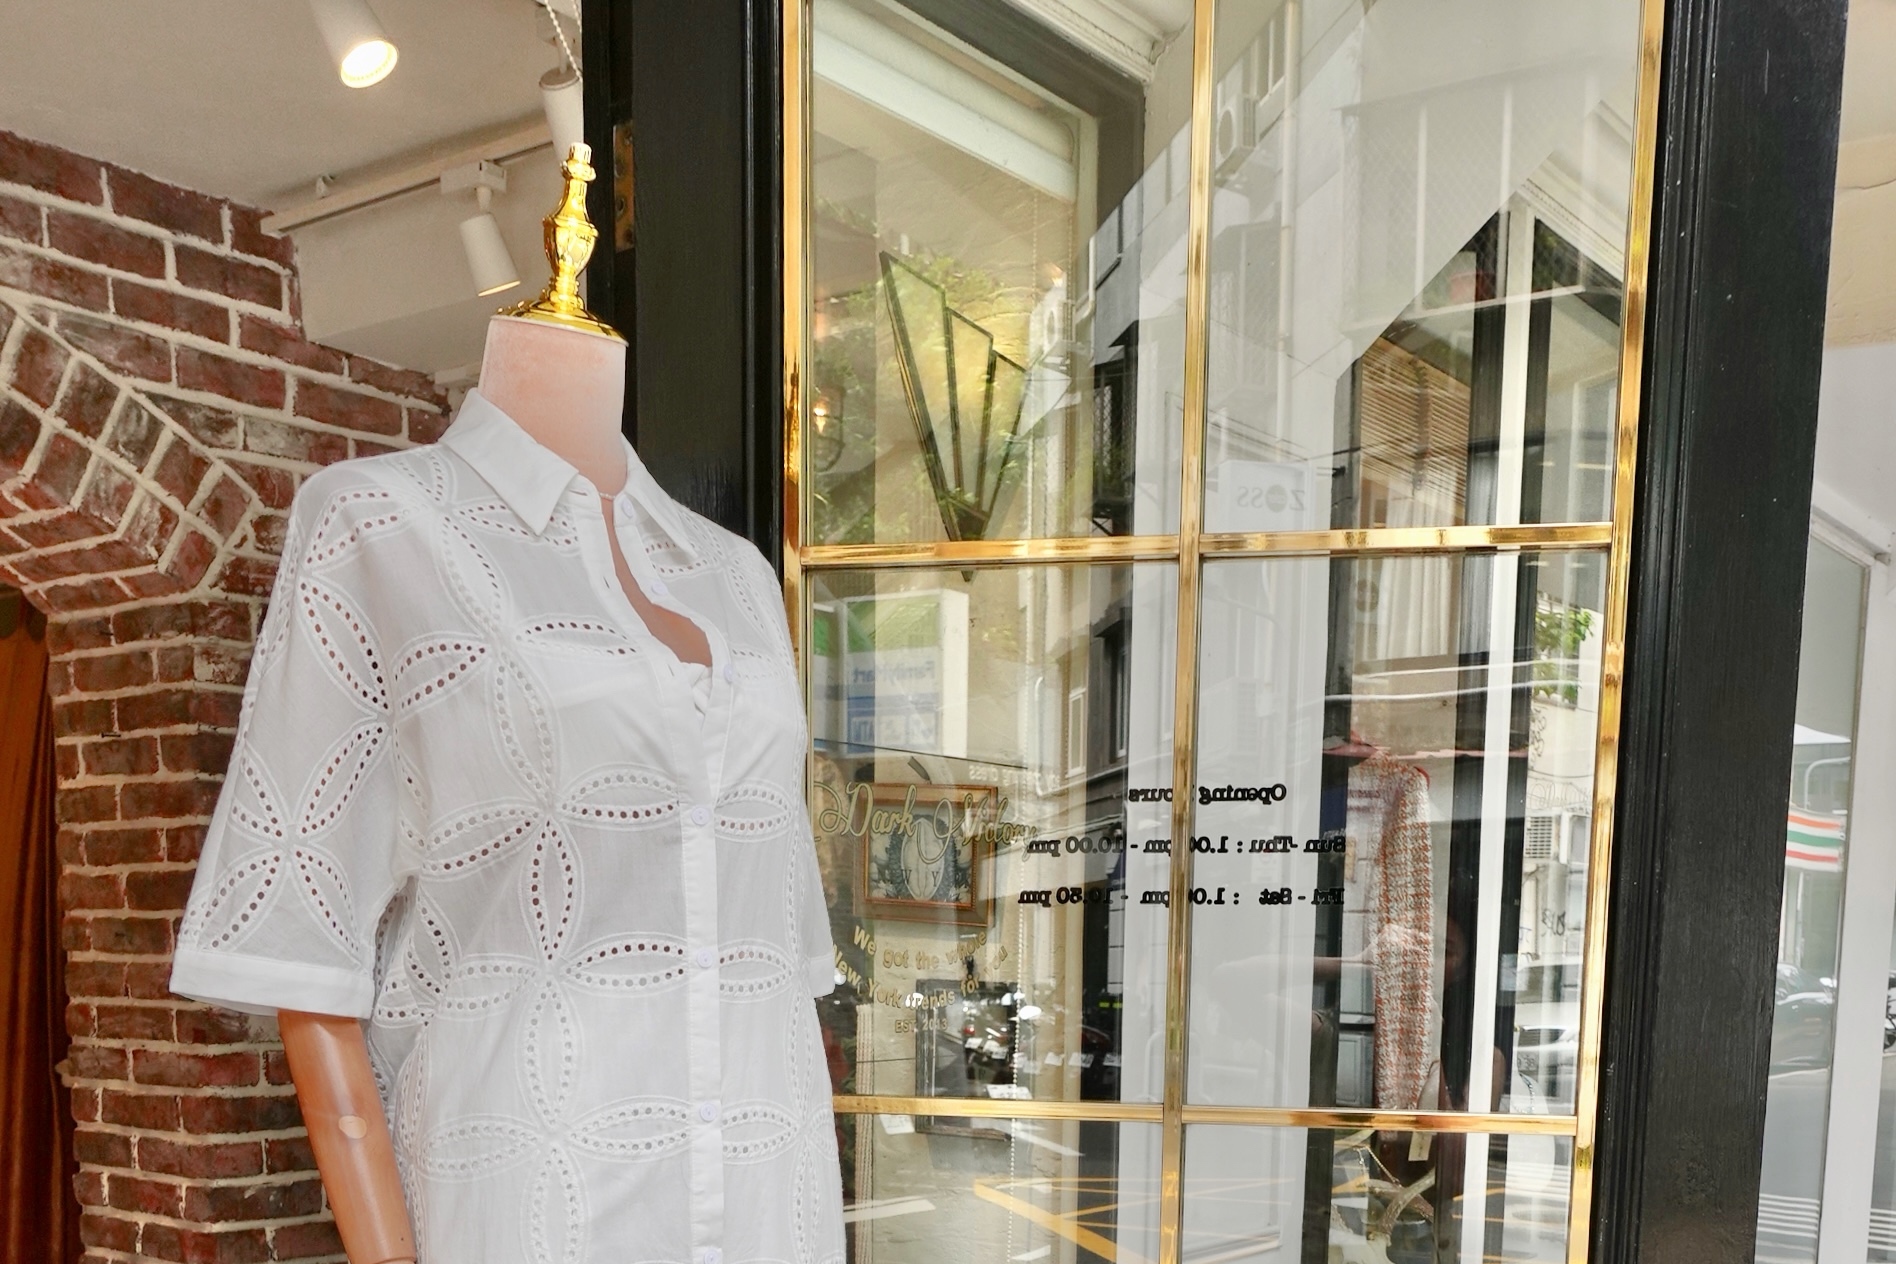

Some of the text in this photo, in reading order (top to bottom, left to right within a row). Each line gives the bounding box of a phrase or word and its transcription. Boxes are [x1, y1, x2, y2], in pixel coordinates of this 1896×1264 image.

[818, 781, 918, 838] Dark
[854, 925, 877, 956] We
[882, 949, 909, 969] got
[915, 951, 941, 970] the
[868, 976, 903, 1009] York
[960, 974, 981, 997] for
